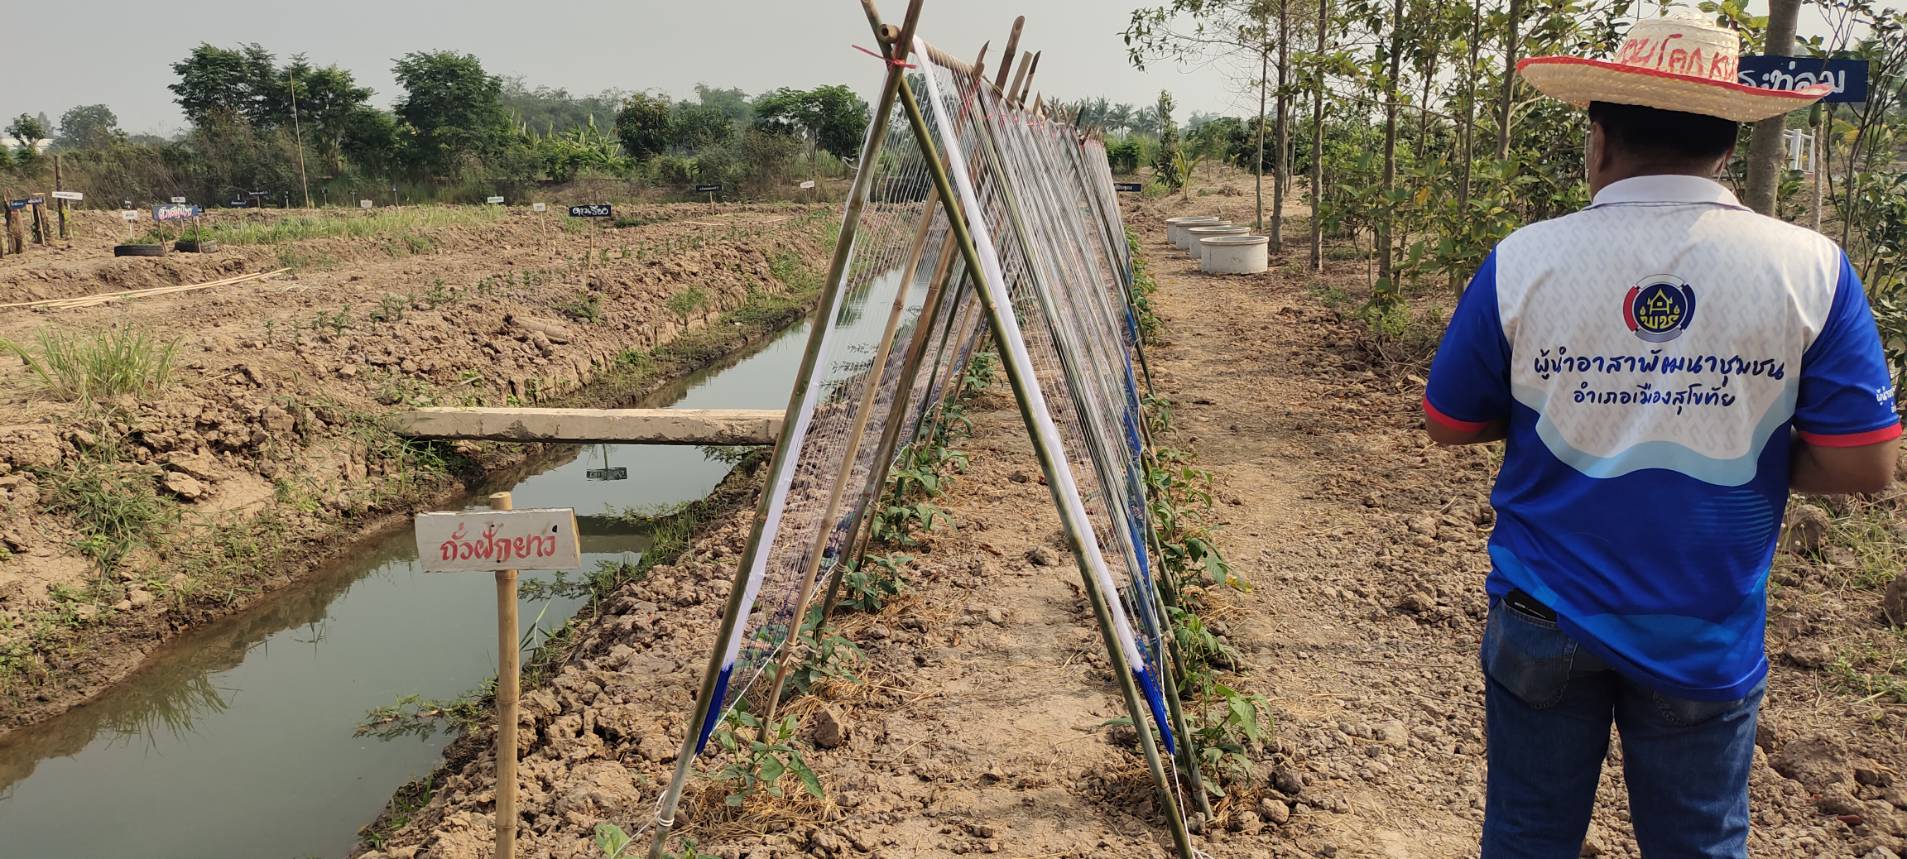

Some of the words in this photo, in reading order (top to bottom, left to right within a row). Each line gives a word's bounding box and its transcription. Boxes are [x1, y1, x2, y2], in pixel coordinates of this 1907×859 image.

[1534, 346, 1785, 387] ผู้นำอาสาพัฒนาชุมชน
[1573, 381, 1736, 415] อำเภอเมืองสุโขทัย
[440, 522, 557, 561] ถั่วฝักยาว
